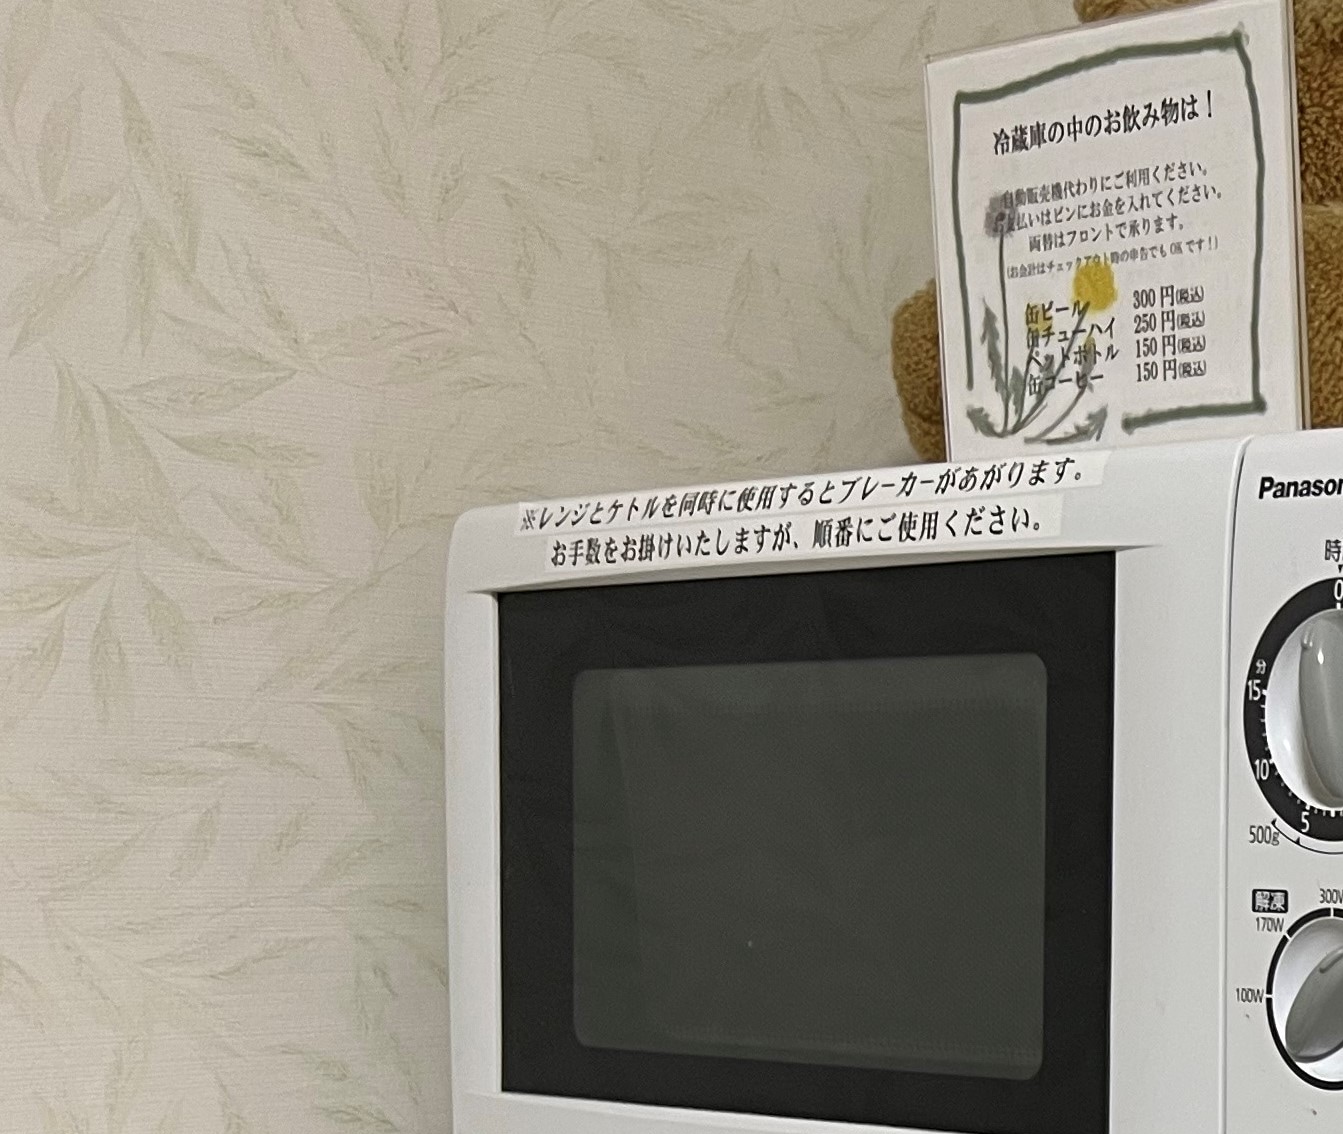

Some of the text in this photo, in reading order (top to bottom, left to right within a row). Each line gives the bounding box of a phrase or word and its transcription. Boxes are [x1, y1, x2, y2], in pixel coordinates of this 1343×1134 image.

[993, 90, 1212, 155] 冷蔵庫の中のお飲み物は！
[993, 184, 1222, 233] 支払いはビンにお金を入れてください。
[551, 505, 1041, 567] お手数をお掛けいたしますが、順番にご使用ください。
[1248, 679, 1262, 700] 15
[1254, 759, 1269, 780] 10
[1300, 811, 1310, 833] 5
[1249, 824, 1280, 846] 500g
[1256, 917, 1285, 932] 170W
[1236, 987, 1265, 1003] 100W
